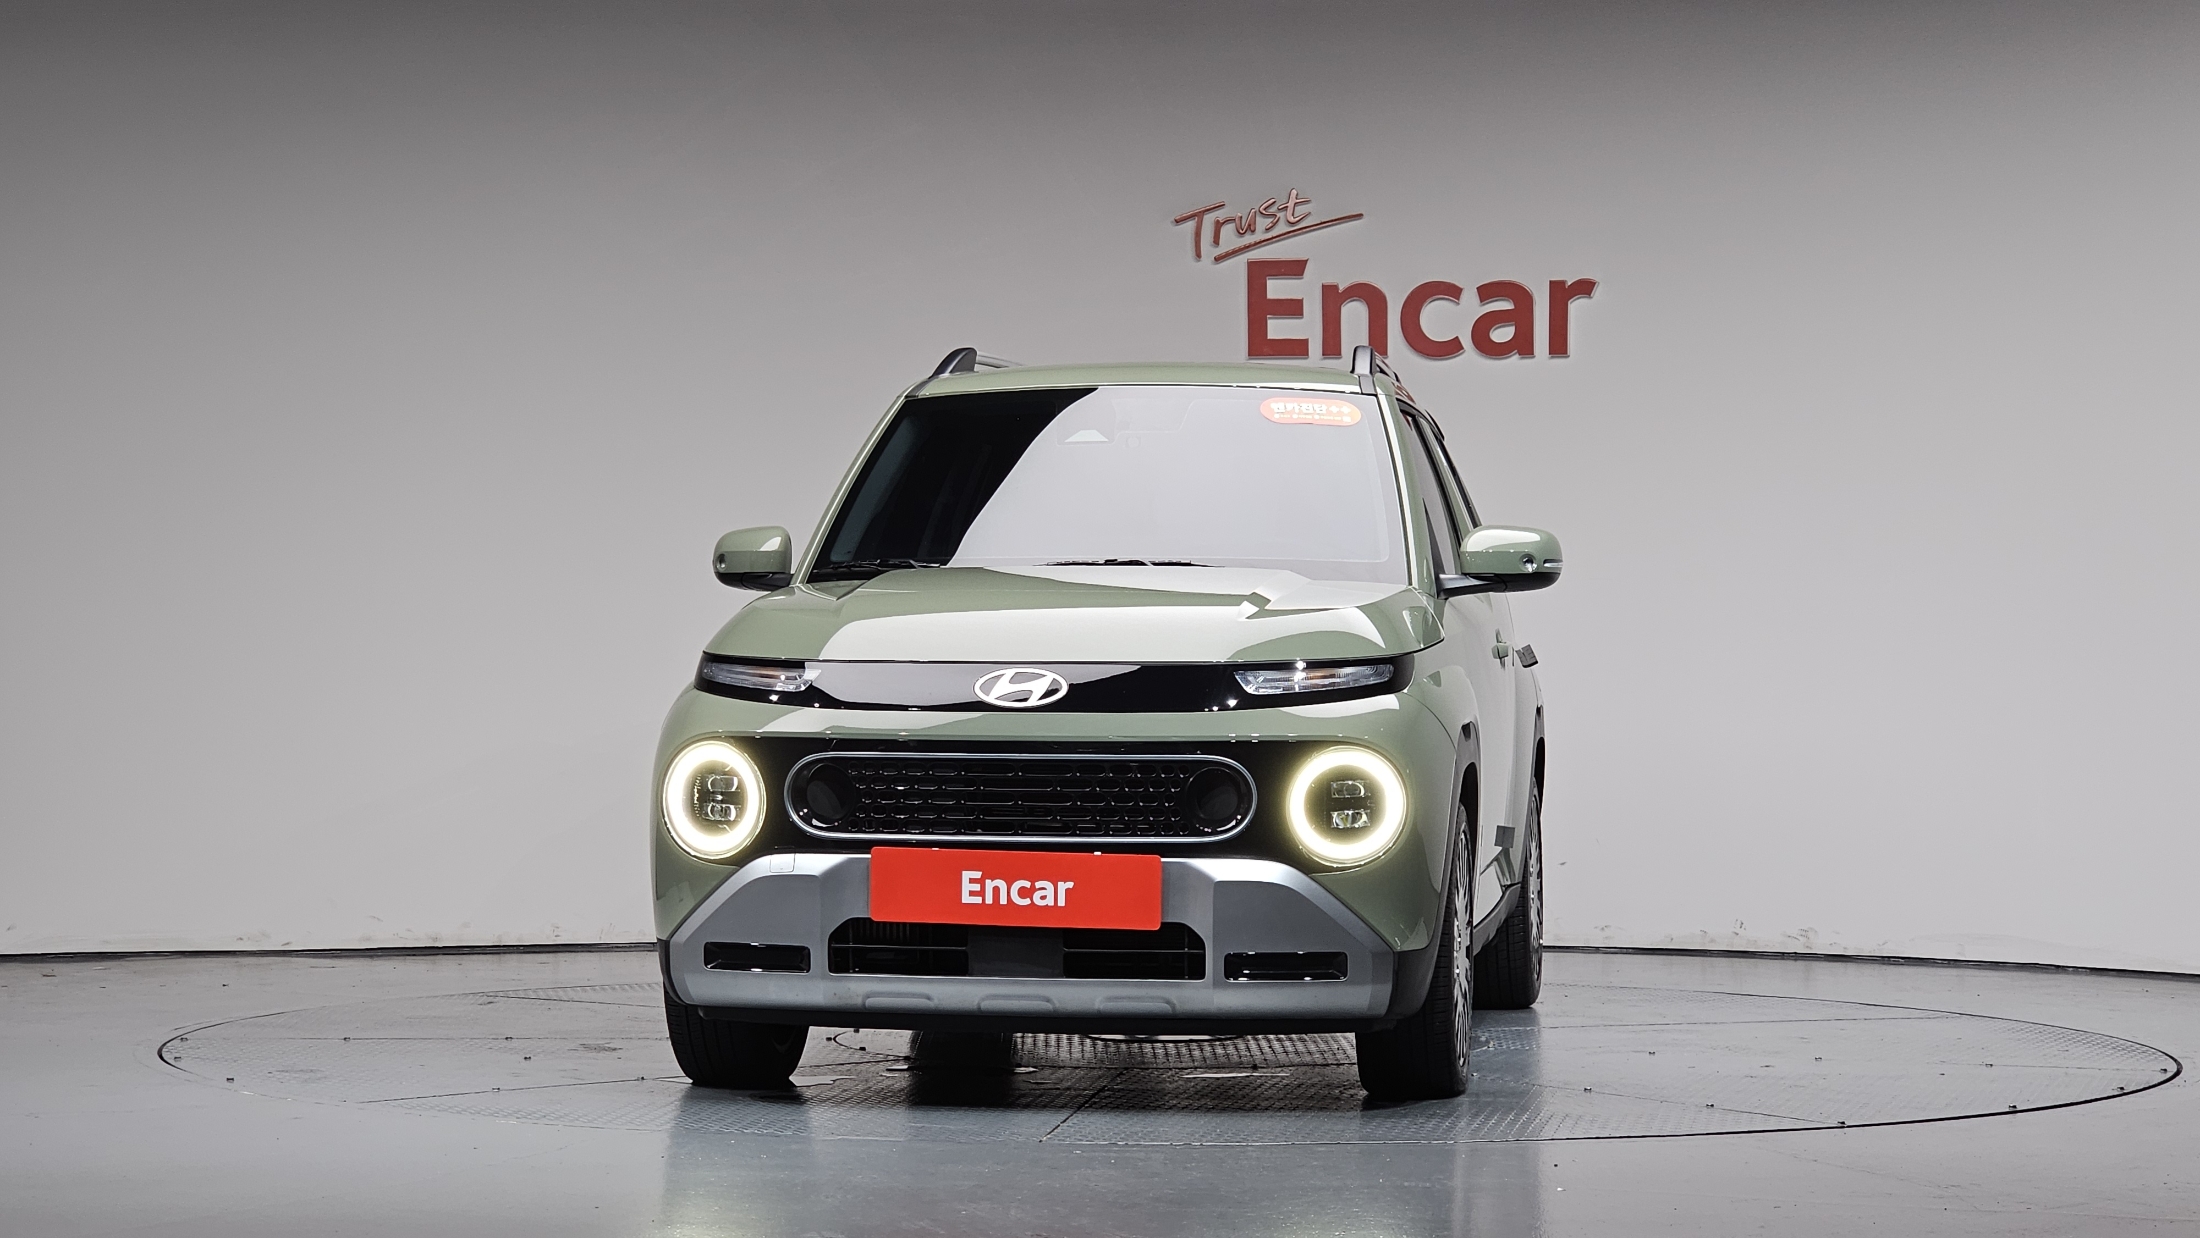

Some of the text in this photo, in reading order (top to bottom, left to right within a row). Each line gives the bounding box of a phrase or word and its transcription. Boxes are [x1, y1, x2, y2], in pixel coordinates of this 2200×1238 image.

[1173, 187, 1312, 261] Trust
[1246, 257, 1599, 359] Encar
[960, 870, 1075, 907] Encar
